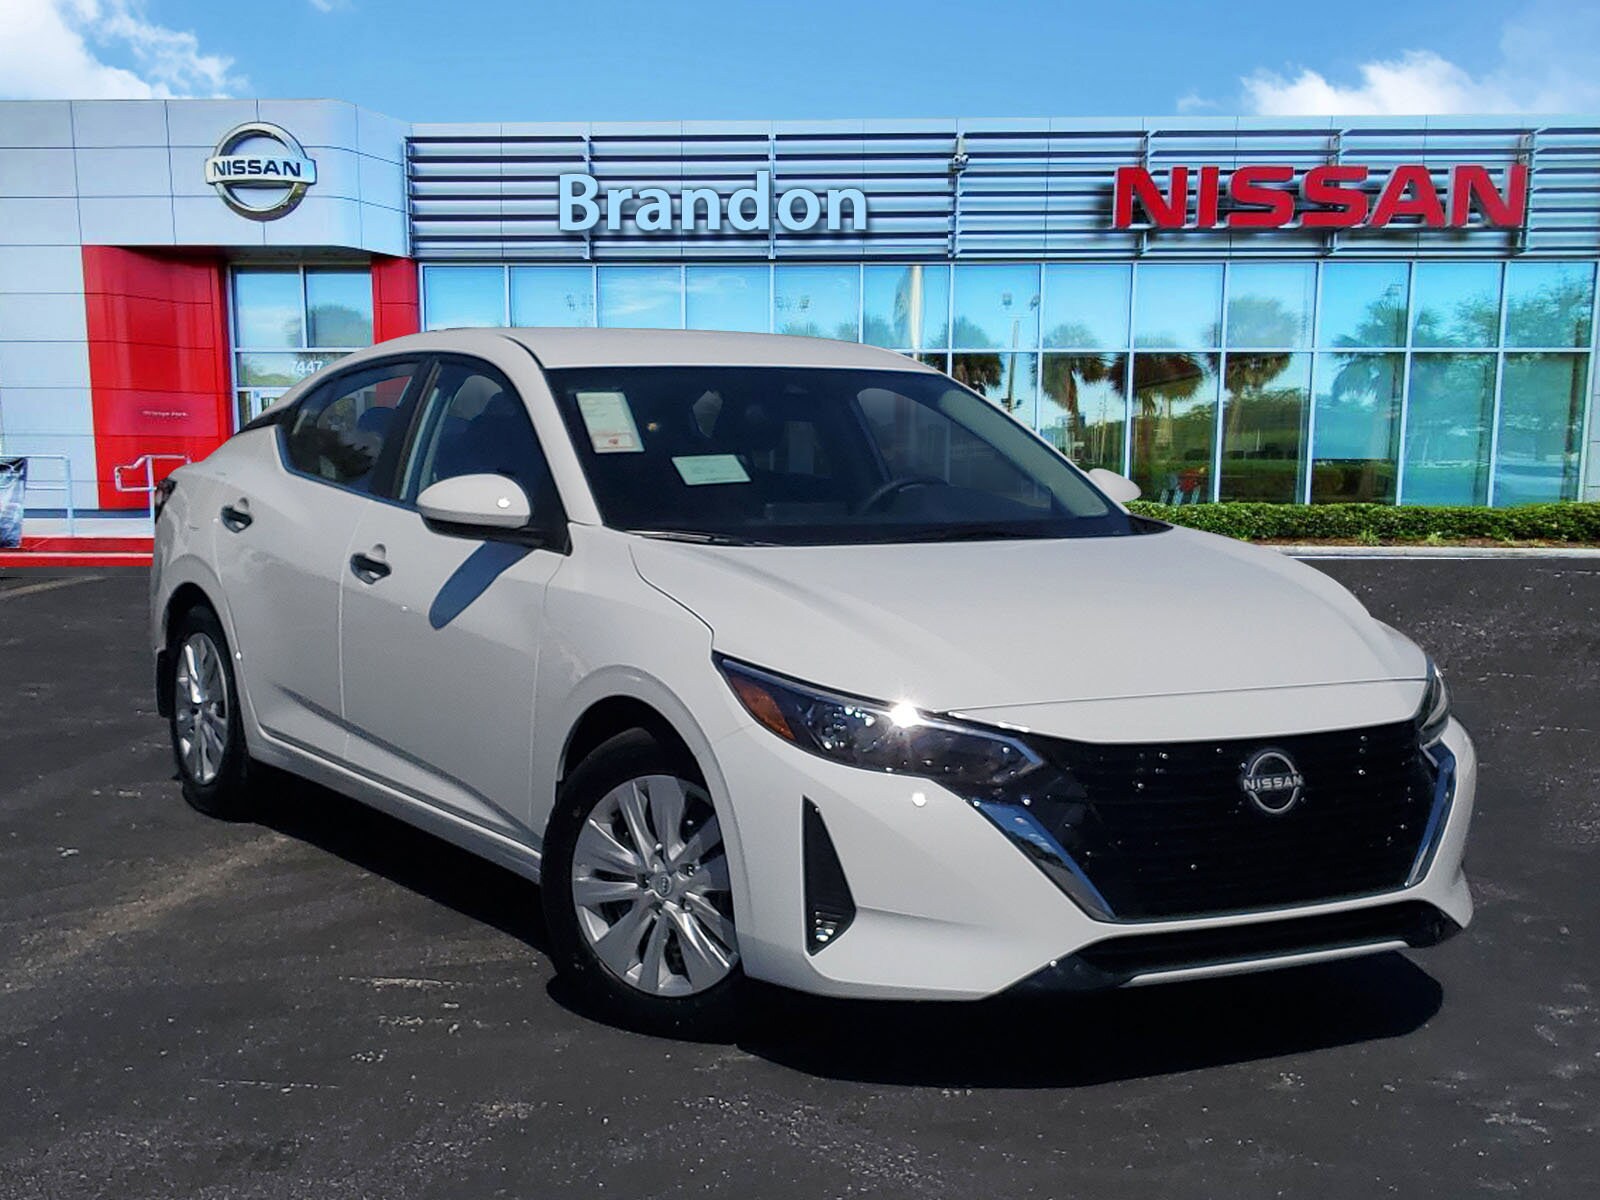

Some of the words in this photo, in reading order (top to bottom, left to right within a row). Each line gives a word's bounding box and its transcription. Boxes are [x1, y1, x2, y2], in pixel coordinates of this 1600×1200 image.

[213, 160, 301, 177] NISSAN
[559, 170, 867, 231] Brandon
[1114, 165, 1529, 229] NISSAN
[1243, 774, 1303, 791] NISSAN
